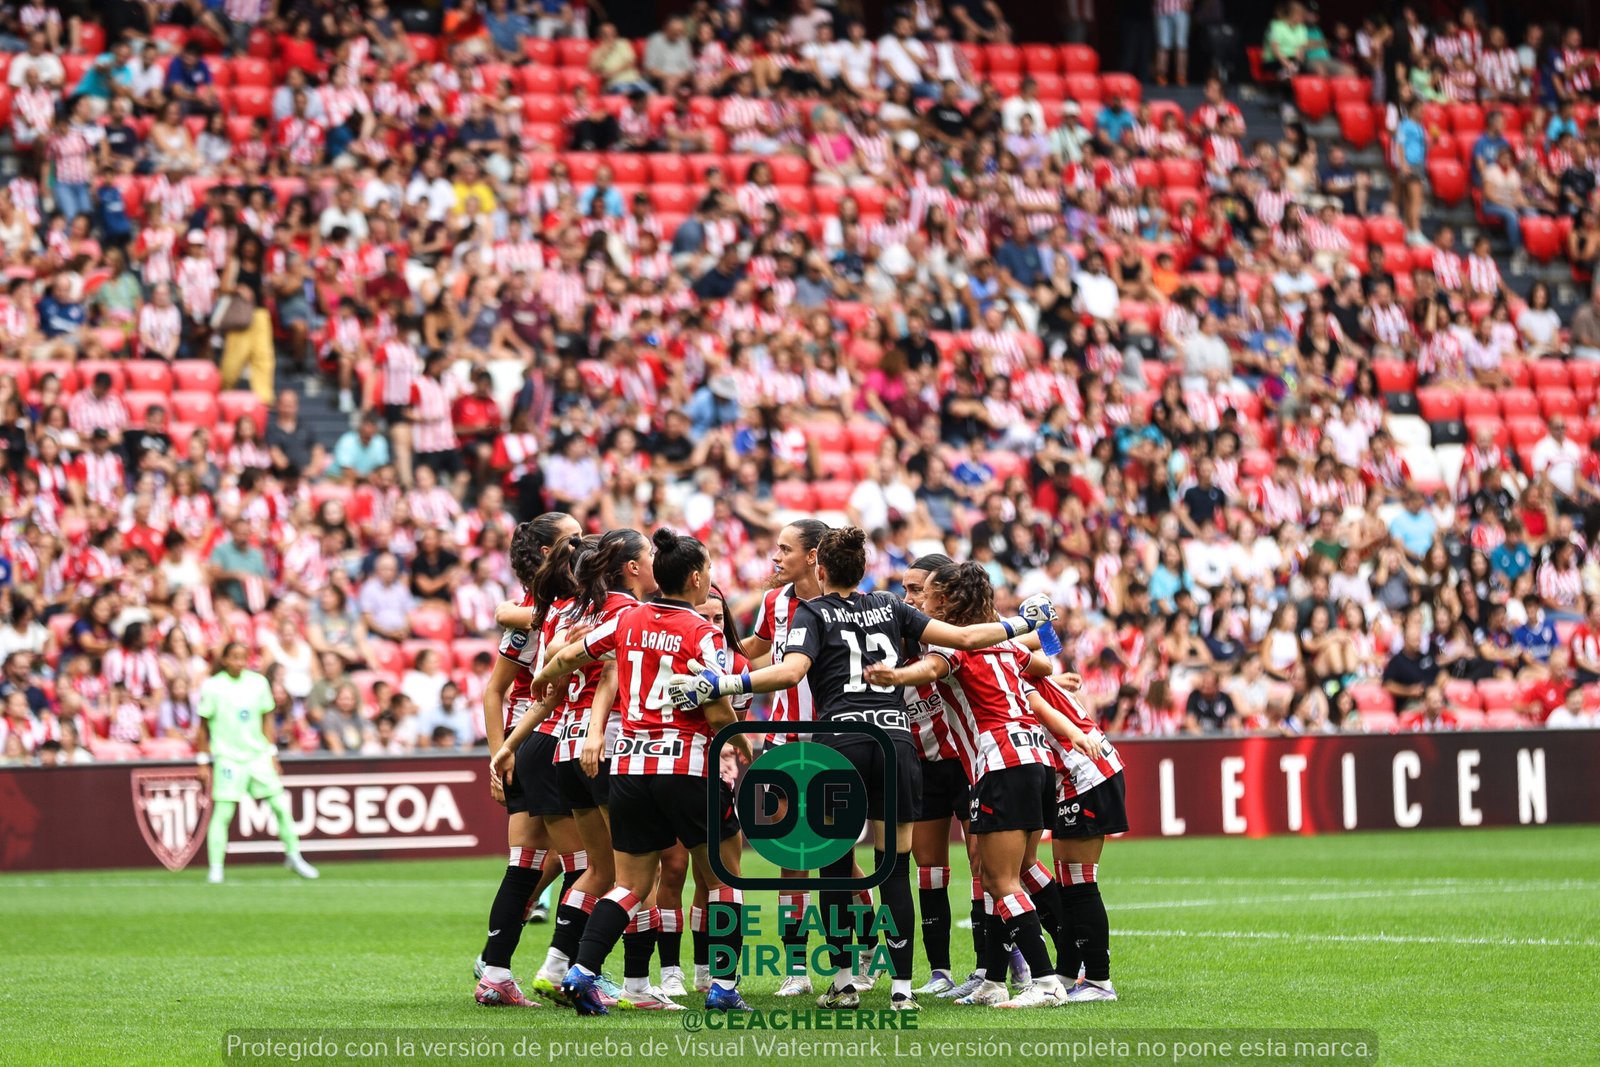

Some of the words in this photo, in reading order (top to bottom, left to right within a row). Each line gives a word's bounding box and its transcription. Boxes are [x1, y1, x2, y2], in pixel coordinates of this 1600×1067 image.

[641, 630, 683, 652] BAÑOS
[627, 650, 676, 723] 14
[613, 738, 682, 757] DIGI
[239, 784, 464, 837] MUSEOA
